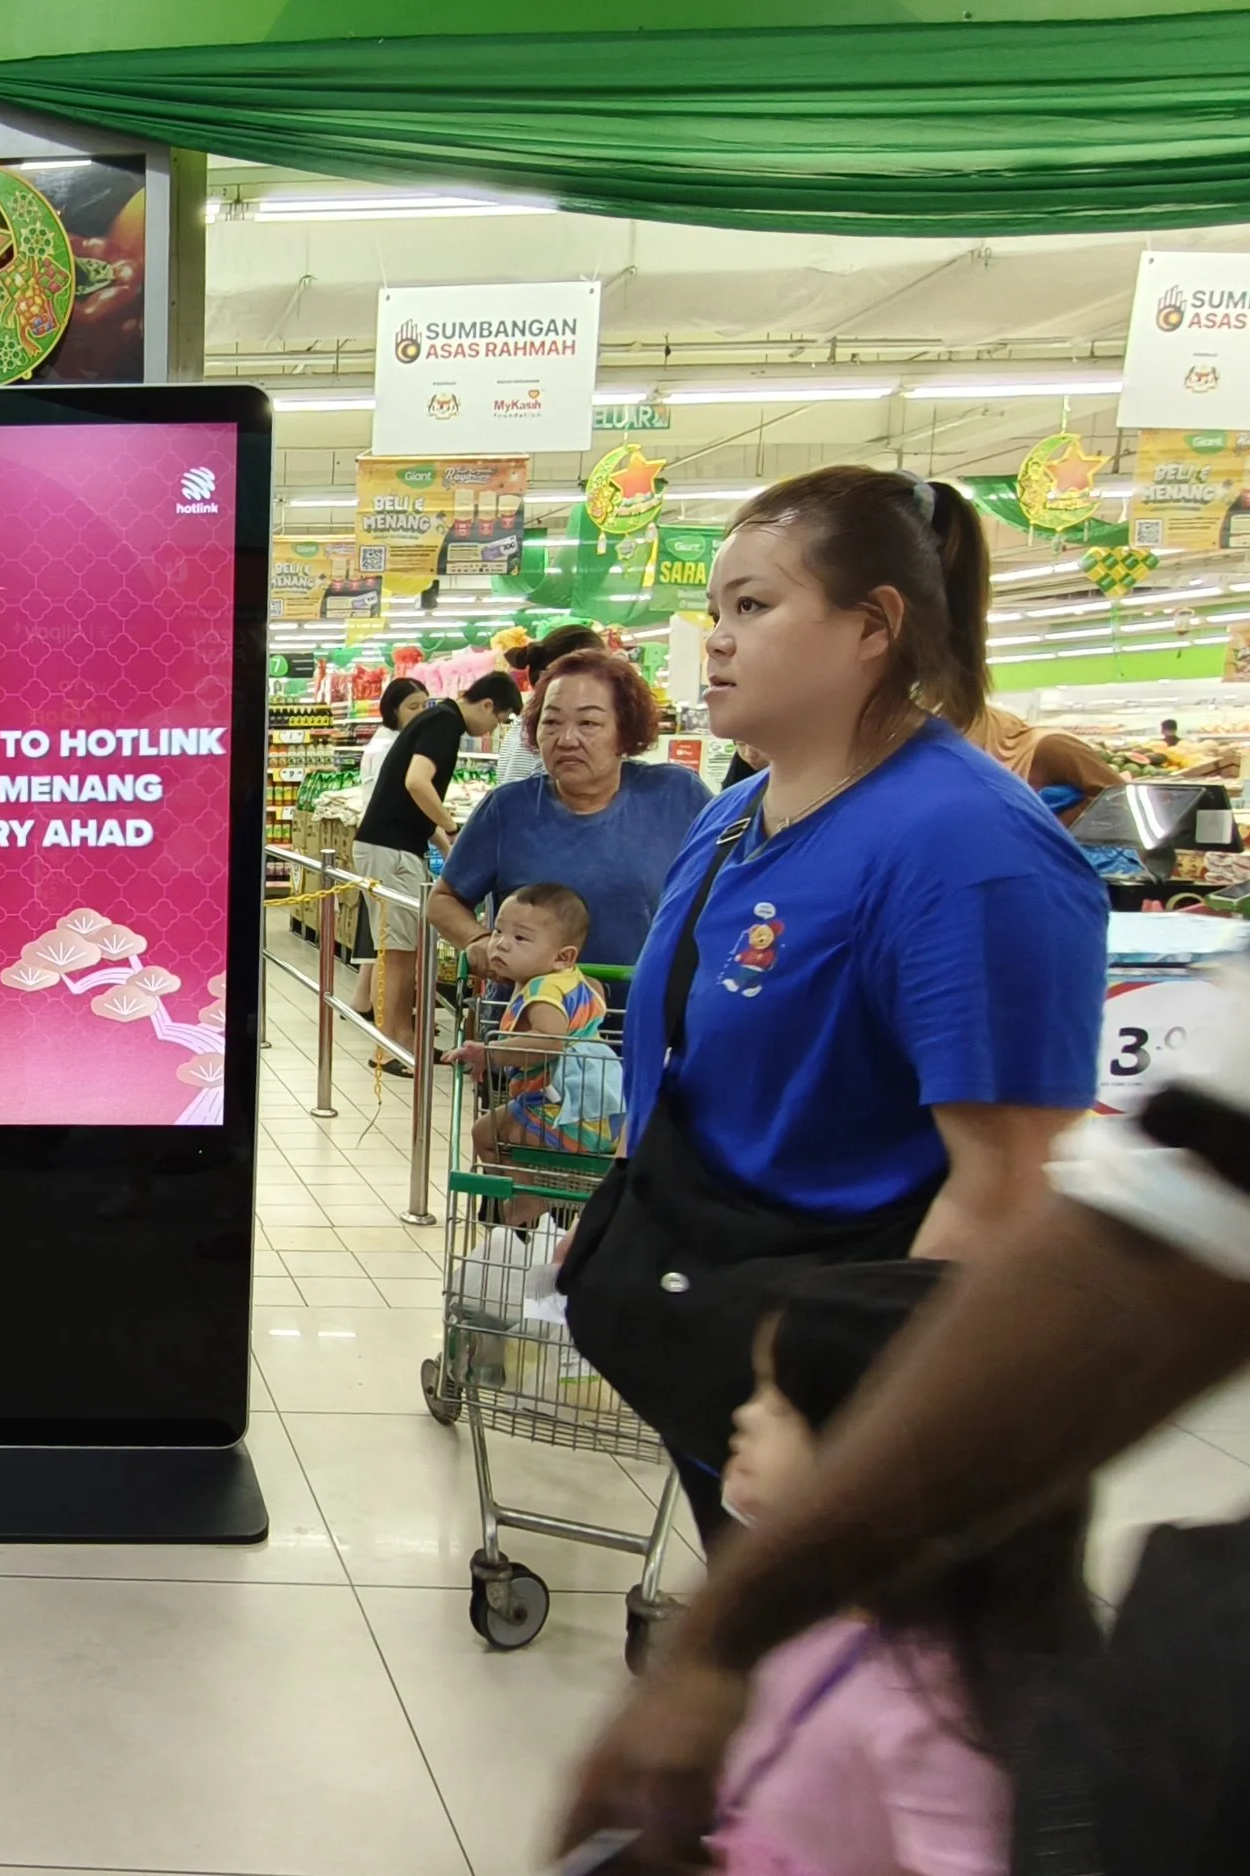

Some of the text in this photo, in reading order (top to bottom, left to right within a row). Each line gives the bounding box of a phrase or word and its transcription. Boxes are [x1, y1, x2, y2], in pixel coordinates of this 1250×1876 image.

[1191, 290, 1250, 310] SUM
[425, 318, 577, 341] SUMBANGAN
[1187, 312, 1248, 330] ASAS
[425, 340, 576, 359] ASAS RAHMAH
[493, 399, 542, 413] MyKasih
[404, 471, 432, 482] Giant
[175, 502, 219, 515] hotlink
[373, 495, 409, 512] BELI
[362, 514, 432, 534] MENANG
[659, 560, 707, 585] SARA
[270, 658, 281, 673] 7
[0, 729, 50, 759] TO
[59, 726, 228, 757] HOTLINK
[42, 818, 154, 848] AHAD
